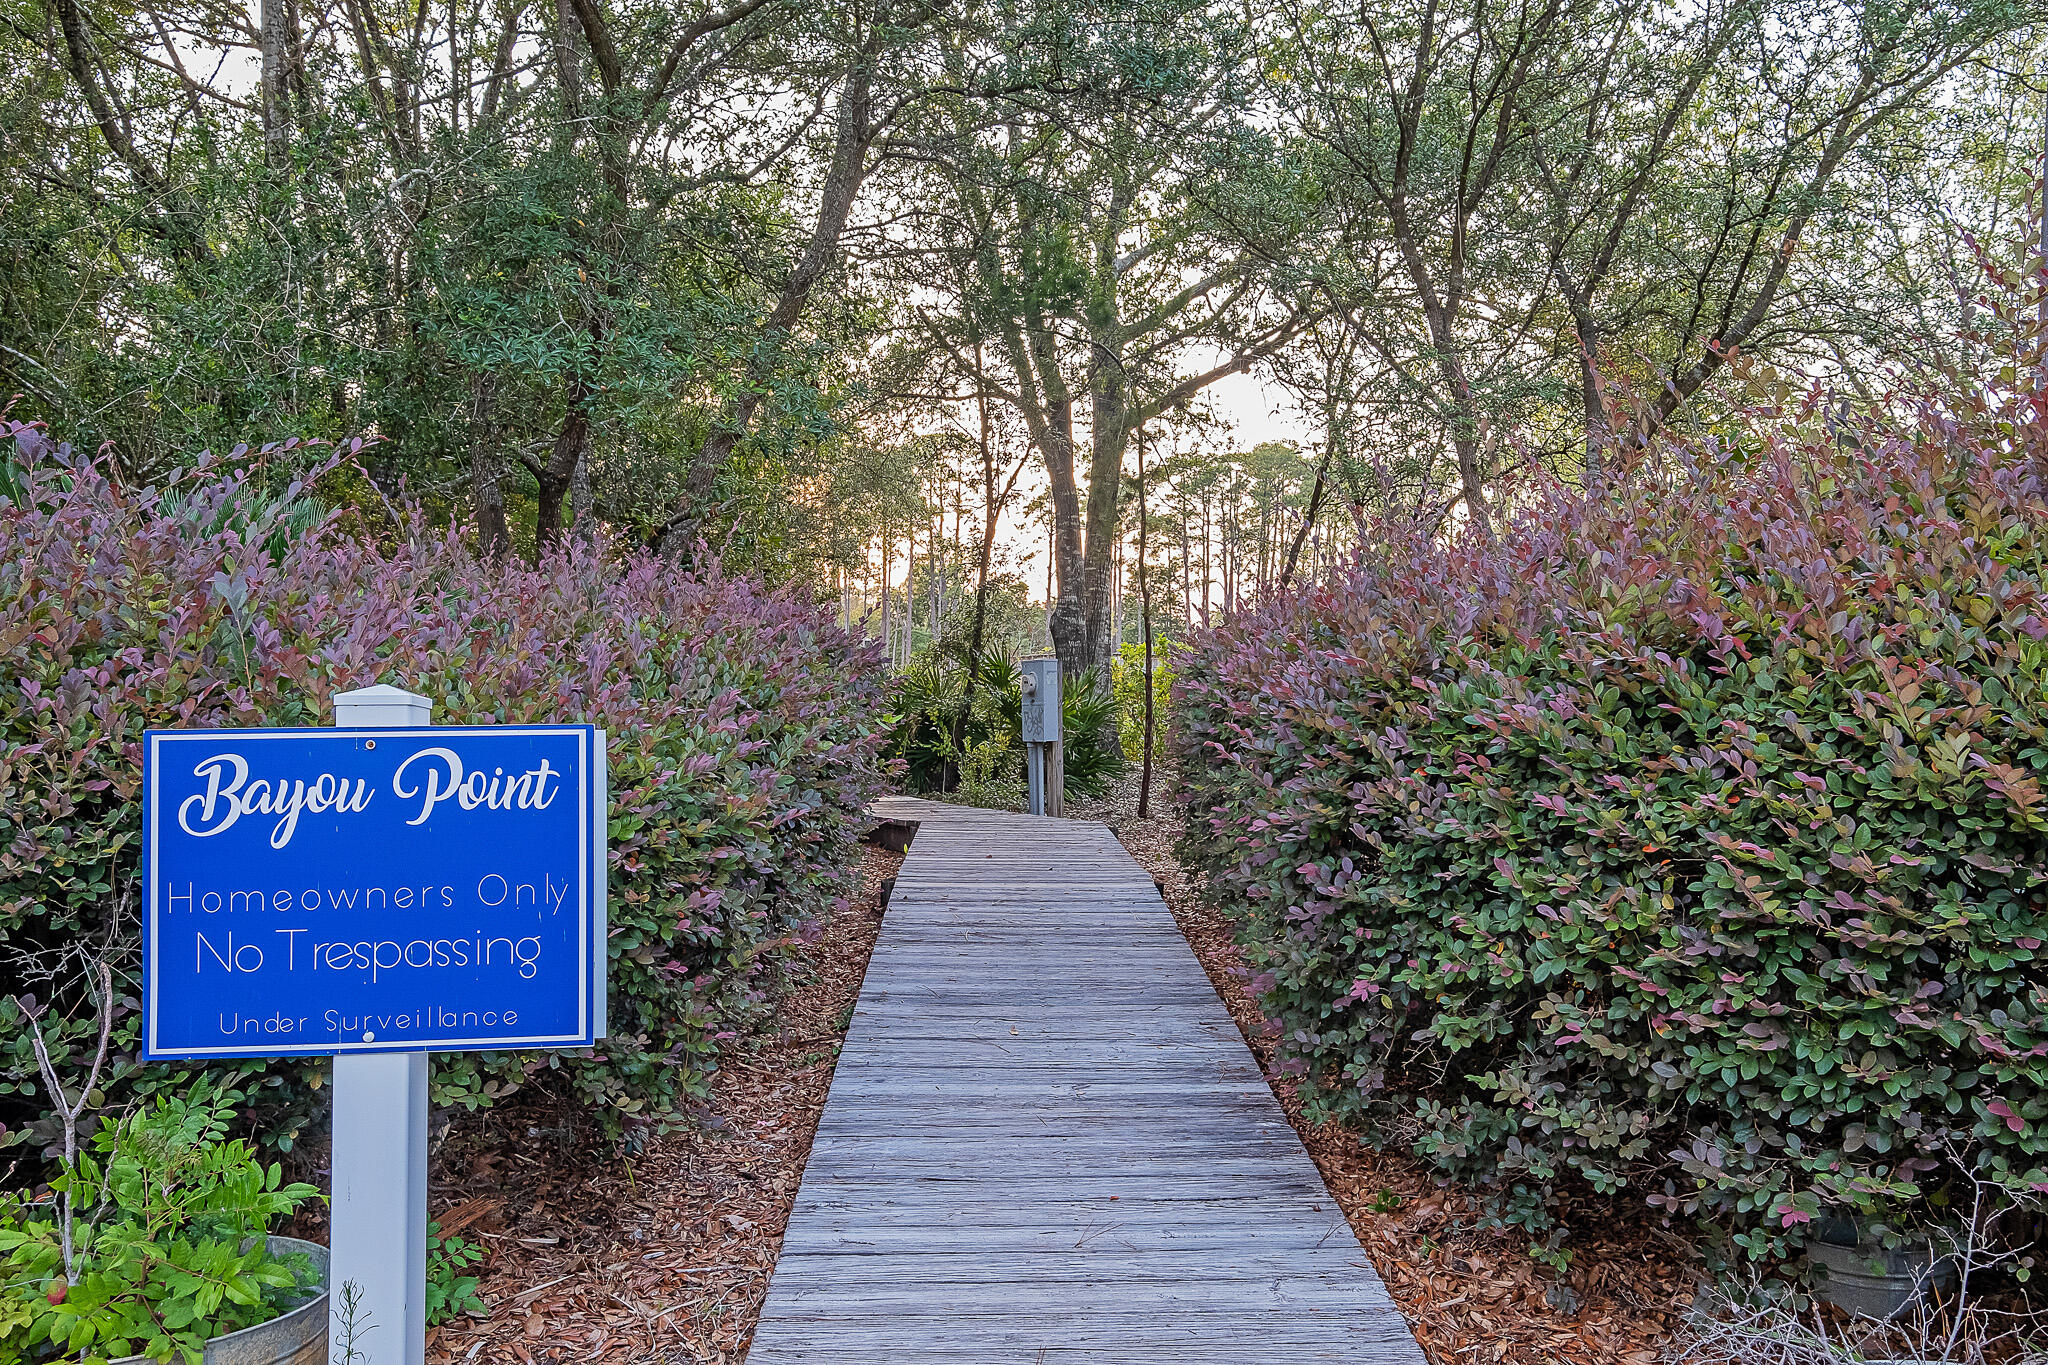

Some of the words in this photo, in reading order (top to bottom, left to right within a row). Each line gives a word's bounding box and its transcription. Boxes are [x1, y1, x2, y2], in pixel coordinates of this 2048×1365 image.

[178, 753, 376, 850] Bayou
[392, 747, 561, 826] Point
[168, 881, 454, 914] Homeowners
[477, 872, 569, 916] Only
[196, 930, 264, 974] No
[275, 929, 541, 984] Trespassing
[220, 1010, 308, 1035] Under
[324, 1005, 519, 1032] Surveillance
